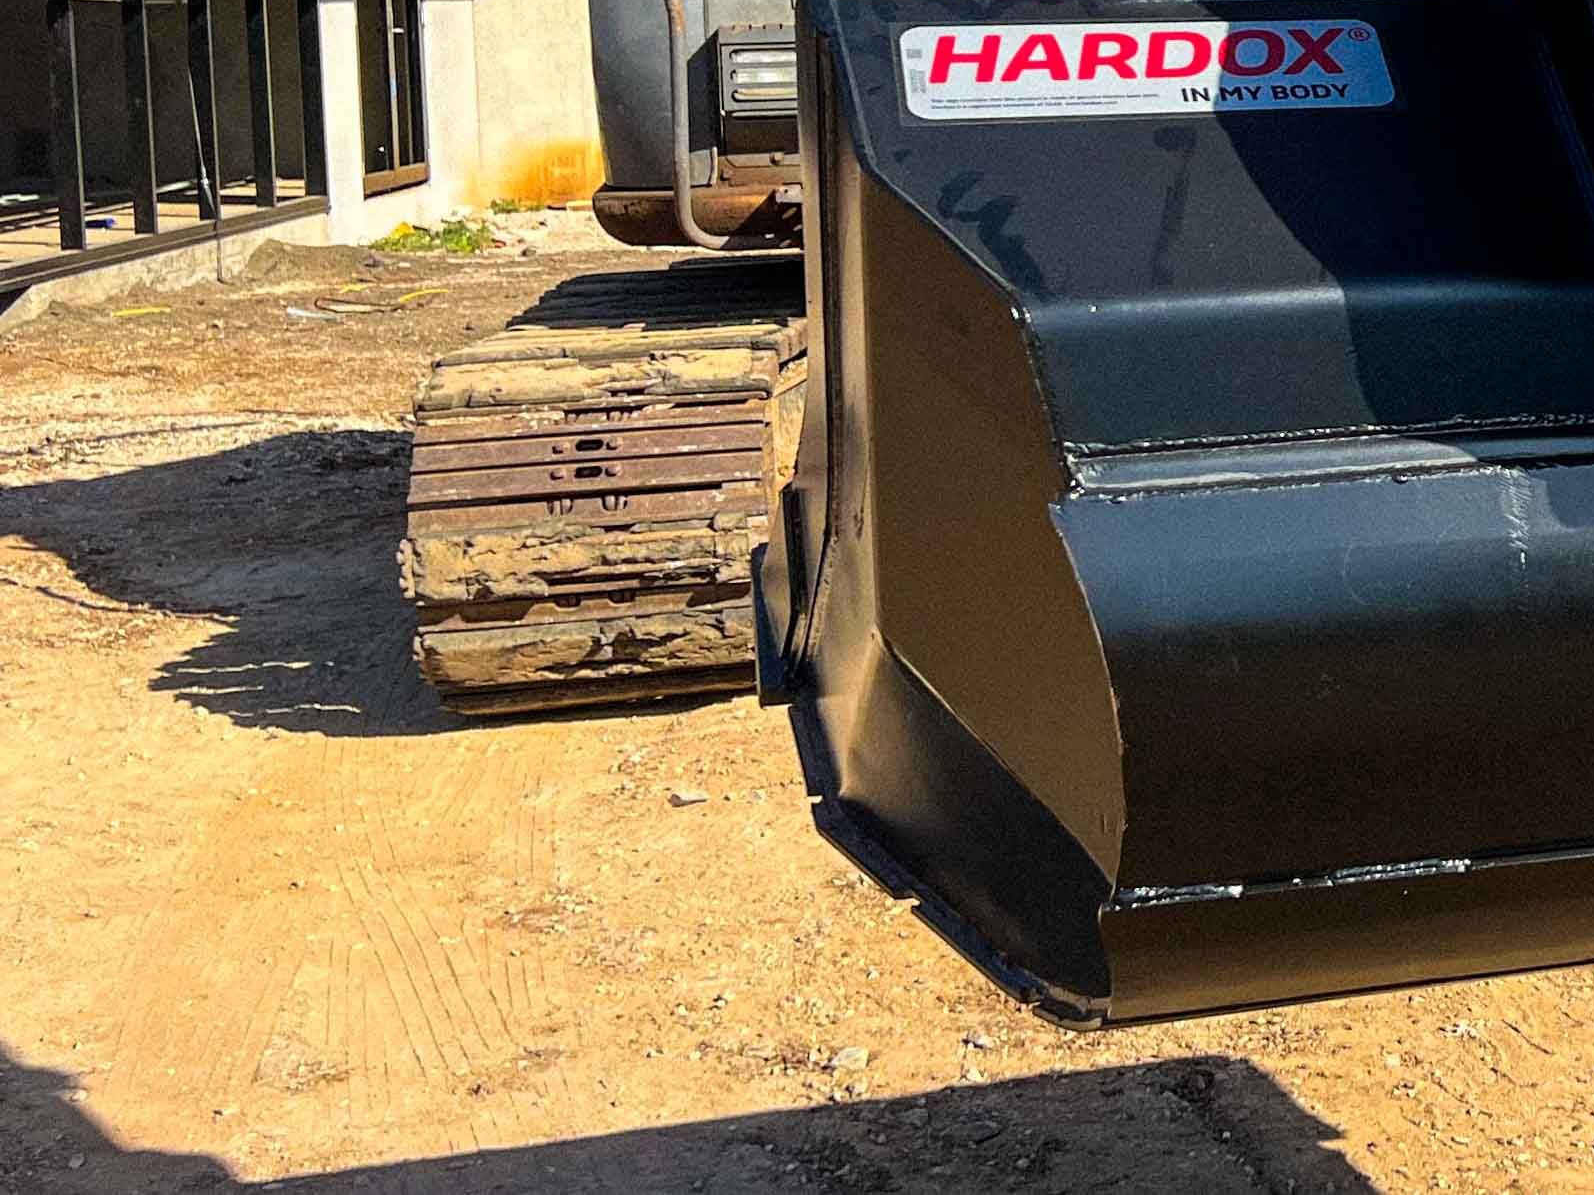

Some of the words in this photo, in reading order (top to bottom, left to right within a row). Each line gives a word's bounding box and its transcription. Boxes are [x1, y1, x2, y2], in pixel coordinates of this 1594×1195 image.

[1182, 87, 1211, 102] IN
[1219, 85, 1262, 101] MY
[1271, 83, 1349, 100] BODY
